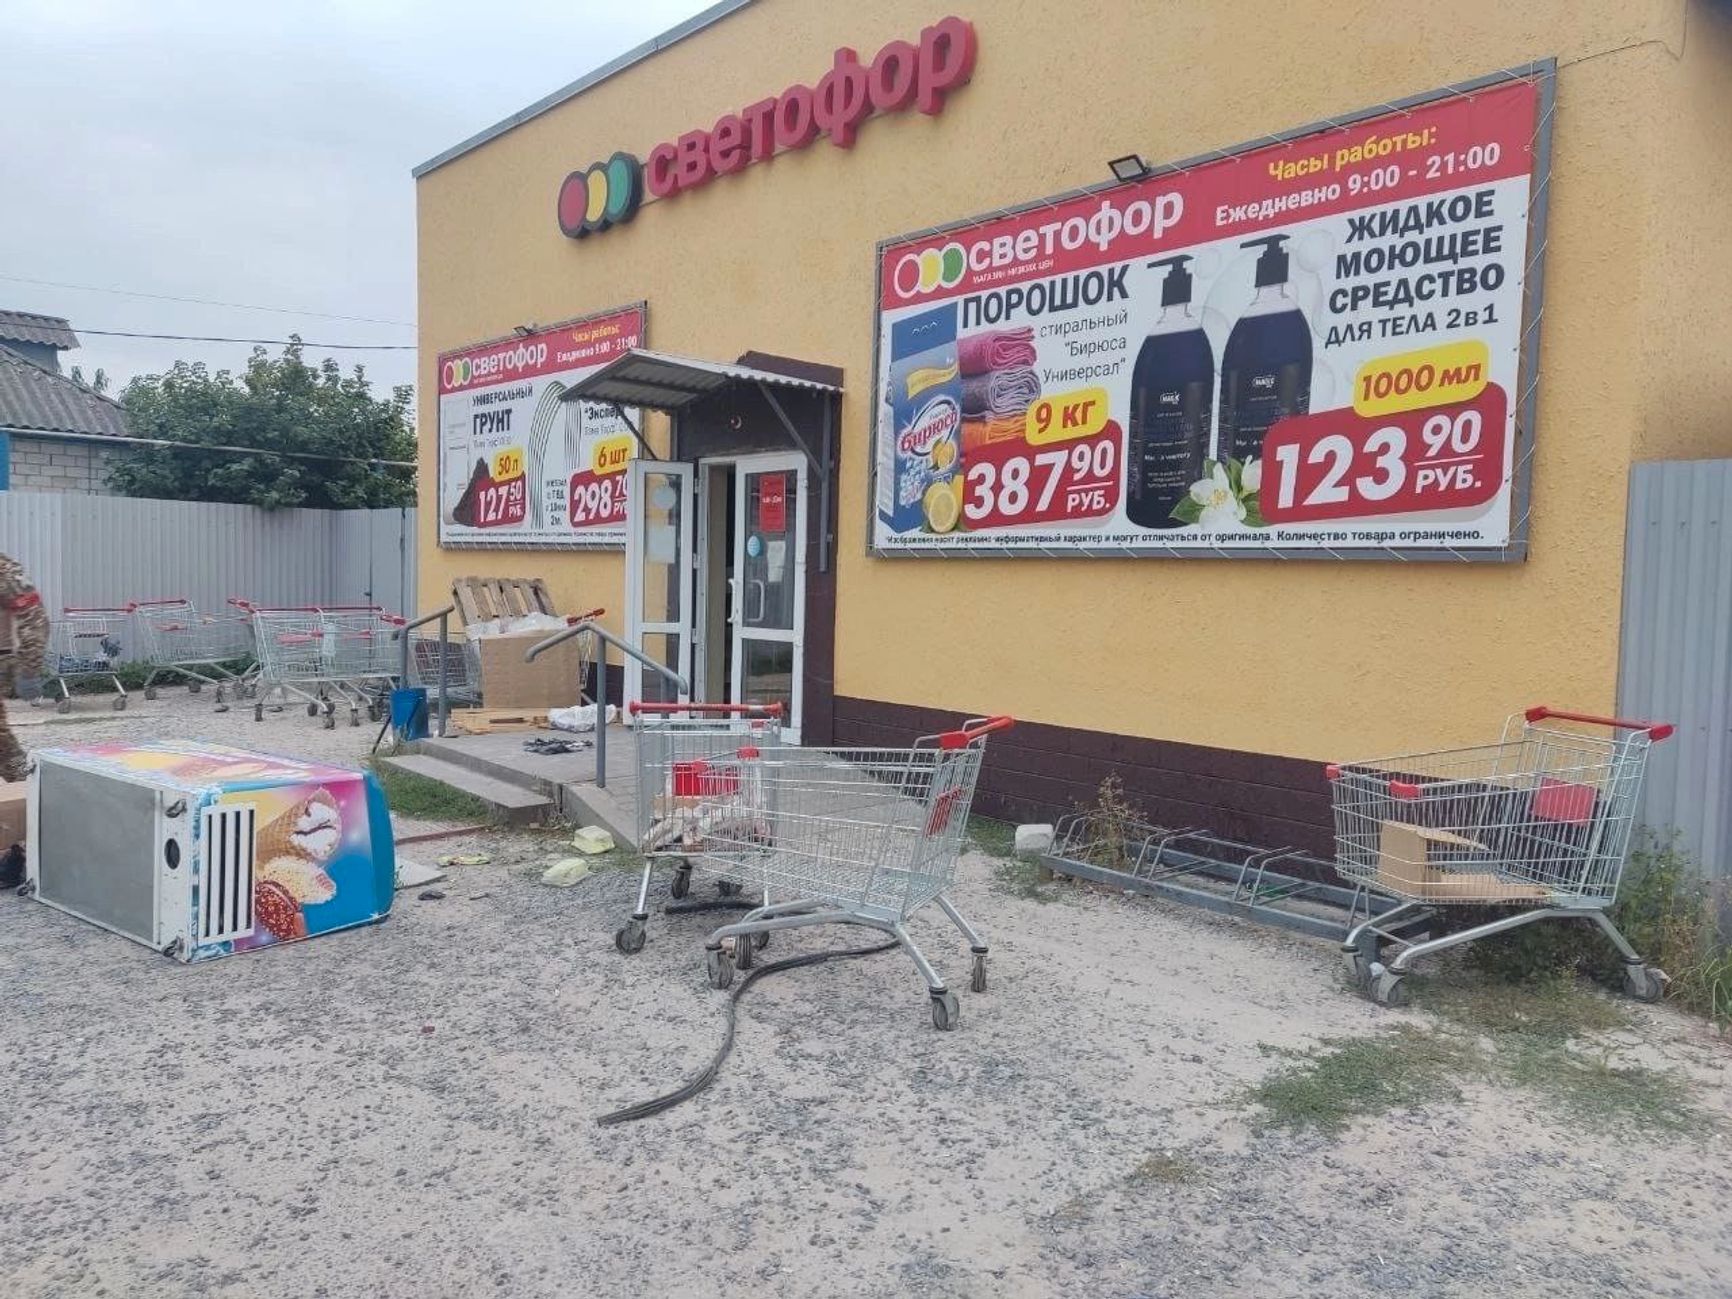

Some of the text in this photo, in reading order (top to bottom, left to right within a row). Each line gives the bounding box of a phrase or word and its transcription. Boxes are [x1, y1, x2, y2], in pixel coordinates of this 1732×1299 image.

[647, 15, 978, 198] светофор
[1269, 126, 1438, 181] Часы работы:
[1215, 182, 1340, 227] Ежедневно
[1348, 165, 1400, 196] 9:00
[1426, 142, 1500, 180] 21:00
[969, 191, 1184, 272] светофор
[1345, 189, 1496, 244] ЖИДКОЕ
[1335, 225, 1504, 280] МОЮЩЕЕ
[963, 264, 1130, 329] ПОРОШОК
[1329, 263, 1505, 314] СРЕДСТВО
[1040, 308, 1128, 339] стиральный
[1325, 321, 1372, 349] ДЛЯ
[1377, 312, 1437, 338] ТЕЛА
[472, 342, 548, 377] светофор
[1064, 337, 1127, 359] "Бирюса
[1043, 359, 1126, 384] Универсал"
[1362, 363, 1482, 402] 1000 мл
[471, 384, 533, 407] УНИВЕРСАЛЬНЫЙ
[473, 408, 513, 436] ГРУНТ
[900, 410, 958, 452] бирюса
[1034, 401, 1052, 434] 9
[1422, 410, 1482, 457] 90
[498, 455, 519, 476] 50 л
[598, 446, 607, 468] 6
[1070, 439, 1114, 481] 90
[1275, 426, 1407, 510] 123
[509, 480, 522, 501] 50
[964, 449, 1069, 521] 387
[1415, 464, 1482, 494] РУБ.
[479, 484, 509, 523] 127
[573, 479, 612, 522] 298
[1067, 489, 1110, 513] РУБ.
[1063, 534, 1102, 544] характер
[1112, 534, 1139, 544] могут
[1142, 533, 1198, 542] отличаться
[1200, 533, 1213, 541] от
[1215, 532, 1275, 543] оригинала.
[1277, 531, 1347, 541] Количество
[1351, 531, 1396, 543] товара
[1399, 529, 1485, 543] ограничено.
